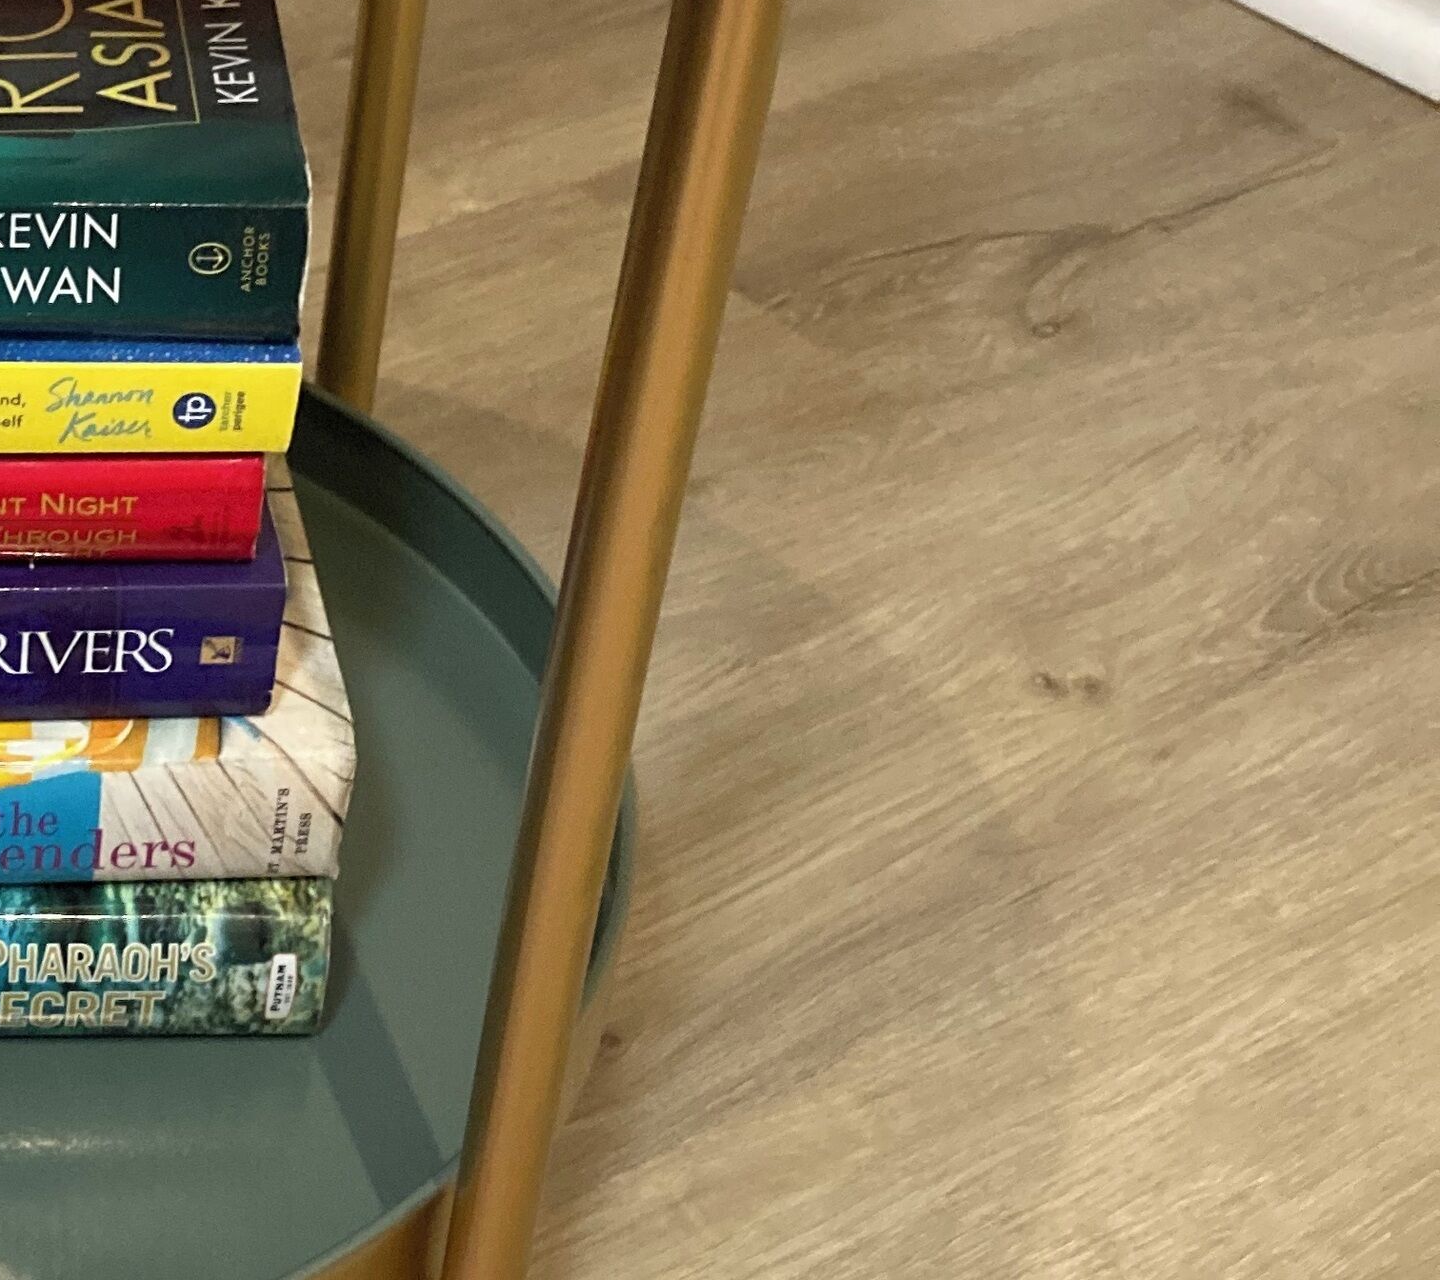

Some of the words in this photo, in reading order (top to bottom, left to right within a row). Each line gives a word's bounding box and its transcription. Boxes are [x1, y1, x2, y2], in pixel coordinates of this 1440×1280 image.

[204, 22, 259, 104] KEVIN
[240, 226, 255, 293] ANCHOR
[255, 232, 271, 286] BOOKS
[45, 376, 155, 412] Shannon
[58, 411, 153, 443] Kaiser
[40, 492, 139, 518] NIGHT
[295, 812, 313, 854] PRESS
[270, 964, 287, 1012] PUTNAM
